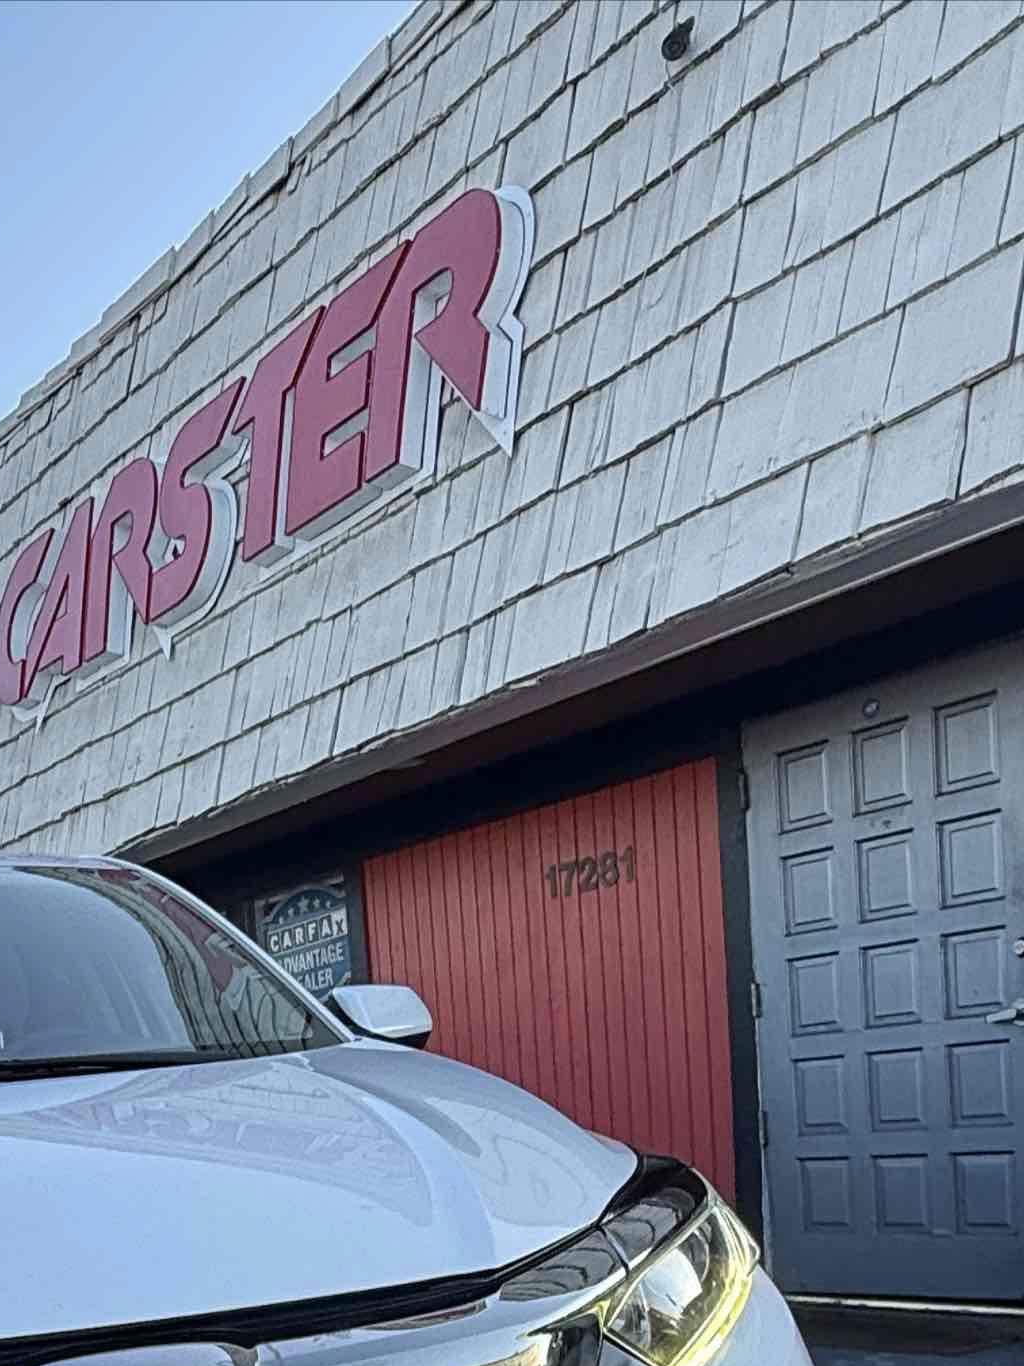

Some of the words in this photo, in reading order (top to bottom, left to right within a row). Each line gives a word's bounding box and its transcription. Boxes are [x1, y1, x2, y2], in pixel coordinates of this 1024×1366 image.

[546, 847, 635, 897] 17281
[268, 912, 346, 953] CARFAX
[297, 968, 334, 991] ALER
